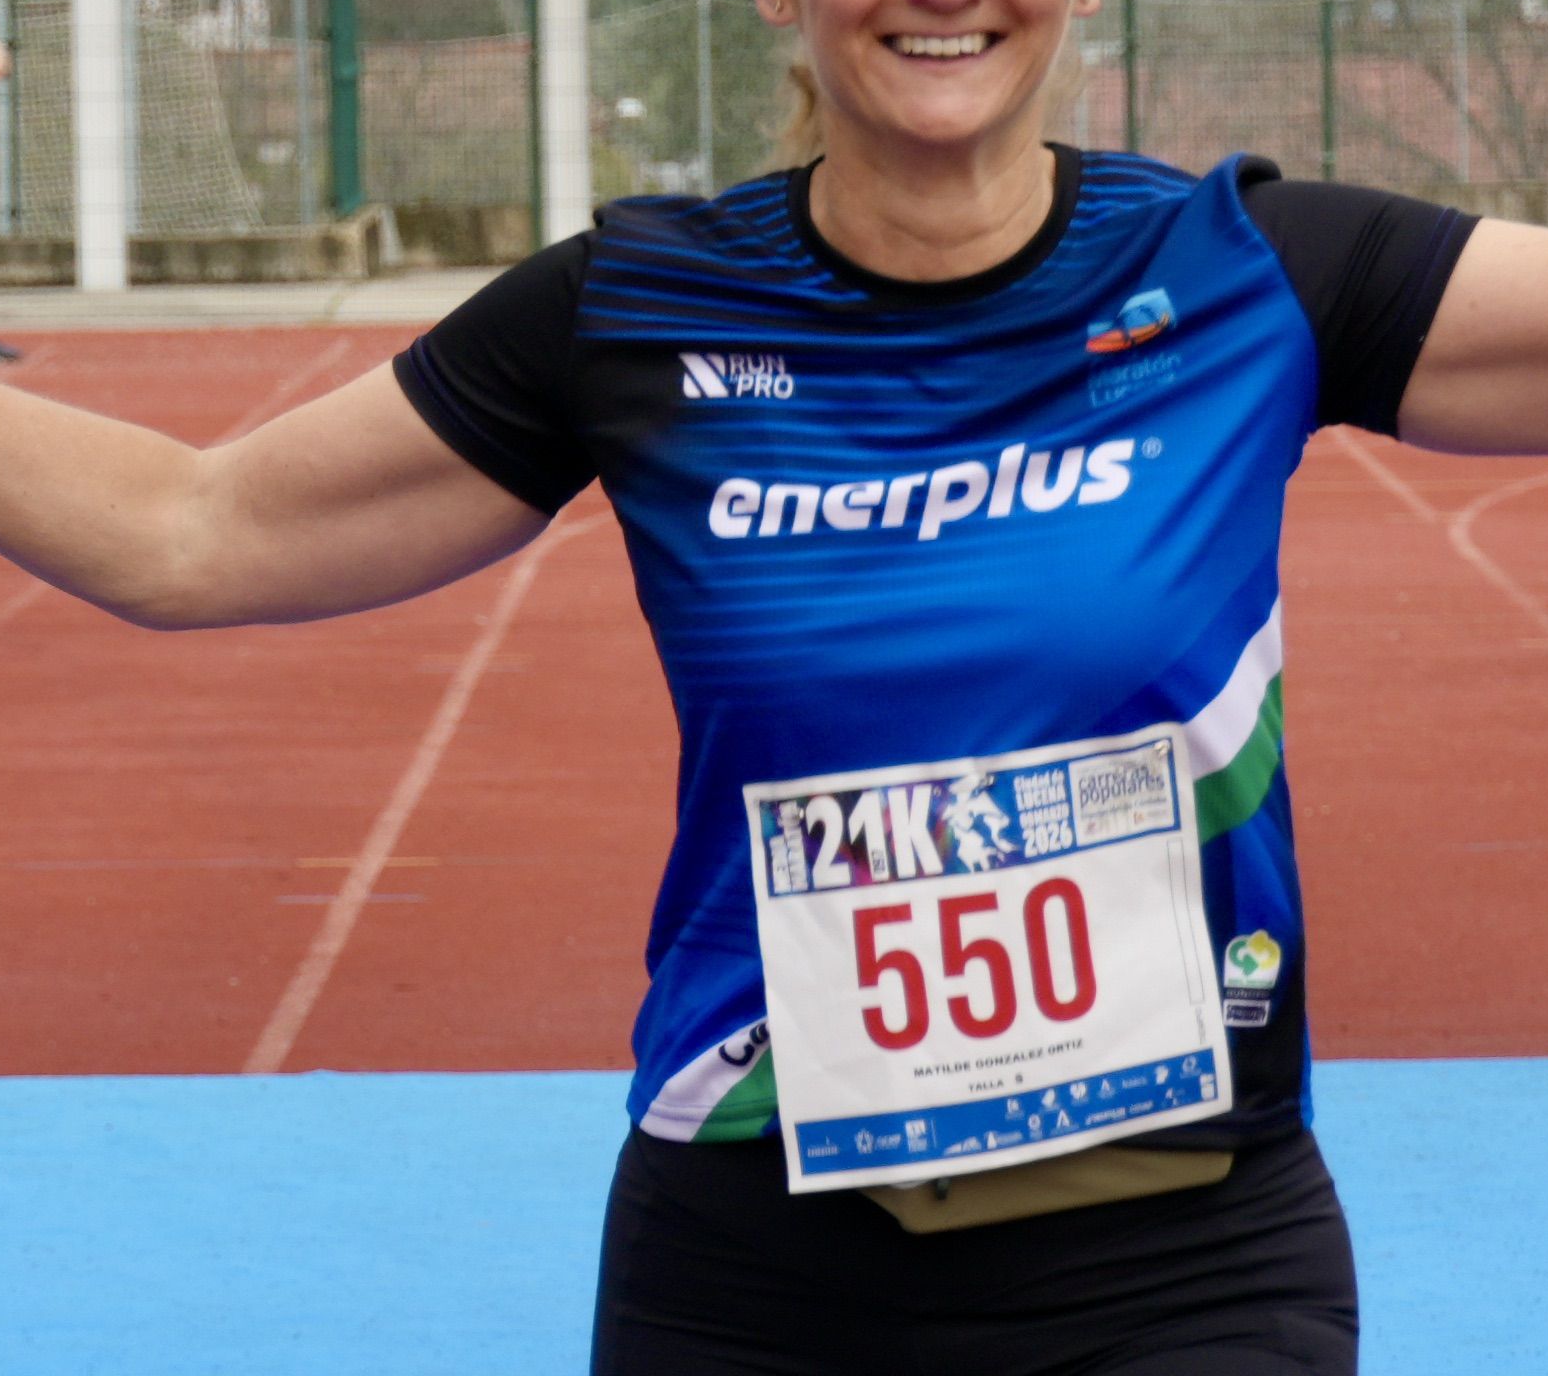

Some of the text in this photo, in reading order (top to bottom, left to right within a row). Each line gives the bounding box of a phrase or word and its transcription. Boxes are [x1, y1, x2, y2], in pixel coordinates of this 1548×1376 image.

[729, 353, 786, 376] RUN
[736, 374, 794, 399] PRO
[806, 784, 944, 889] 21K
[1022, 821, 1073, 858] 2026
[852, 877, 1097, 1051] 550
[914, 1038, 1084, 1078] MATILDE GONZALEZ ORTIZ
